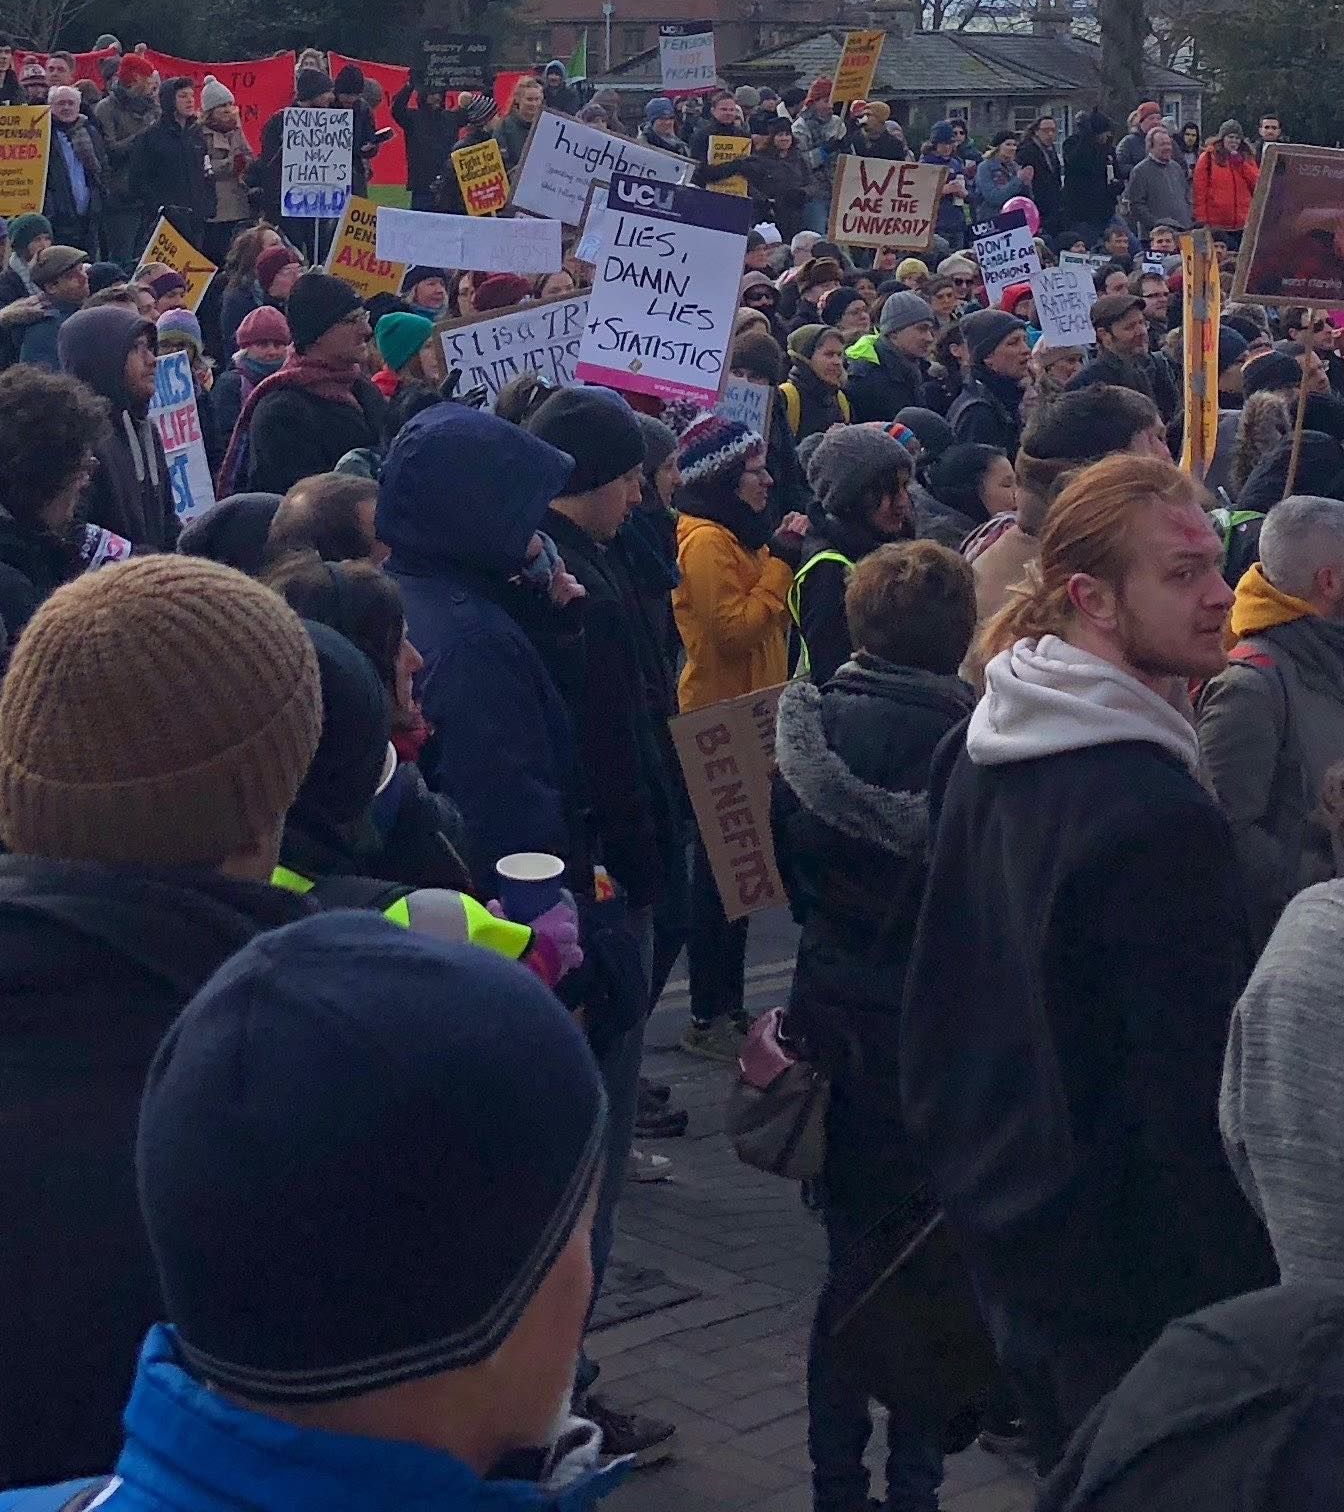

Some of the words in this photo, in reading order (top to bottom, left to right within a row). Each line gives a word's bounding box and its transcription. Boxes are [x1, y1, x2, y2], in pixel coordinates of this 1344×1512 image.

[0, 116, 20, 126] OUR
[285, 110, 327, 132] AXING
[330, 112, 350, 126] OUR
[305, 149, 333, 162] NOW
[284, 164, 346, 182] THAT'S
[860, 160, 919, 198] WE
[617, 180, 674, 210] UCU
[849, 197, 883, 213] ARE
[891, 199, 919, 213] THE
[351, 209, 377, 227] OUR
[843, 213, 930, 236] UNIVERSITY
[158, 233, 178, 257] OUR
[345, 226, 377, 245] PENS
[614, 217, 687, 263] LIES,
[977, 233, 1012, 256] DON'T
[336, 246, 395, 279] AXED.
[604, 256, 690, 297] DAMN
[647, 298, 714, 330] LIES
[492, 326, 513, 351] is
[516, 321, 535, 341] a
[696, 723, 775, 906] BENEFITS
